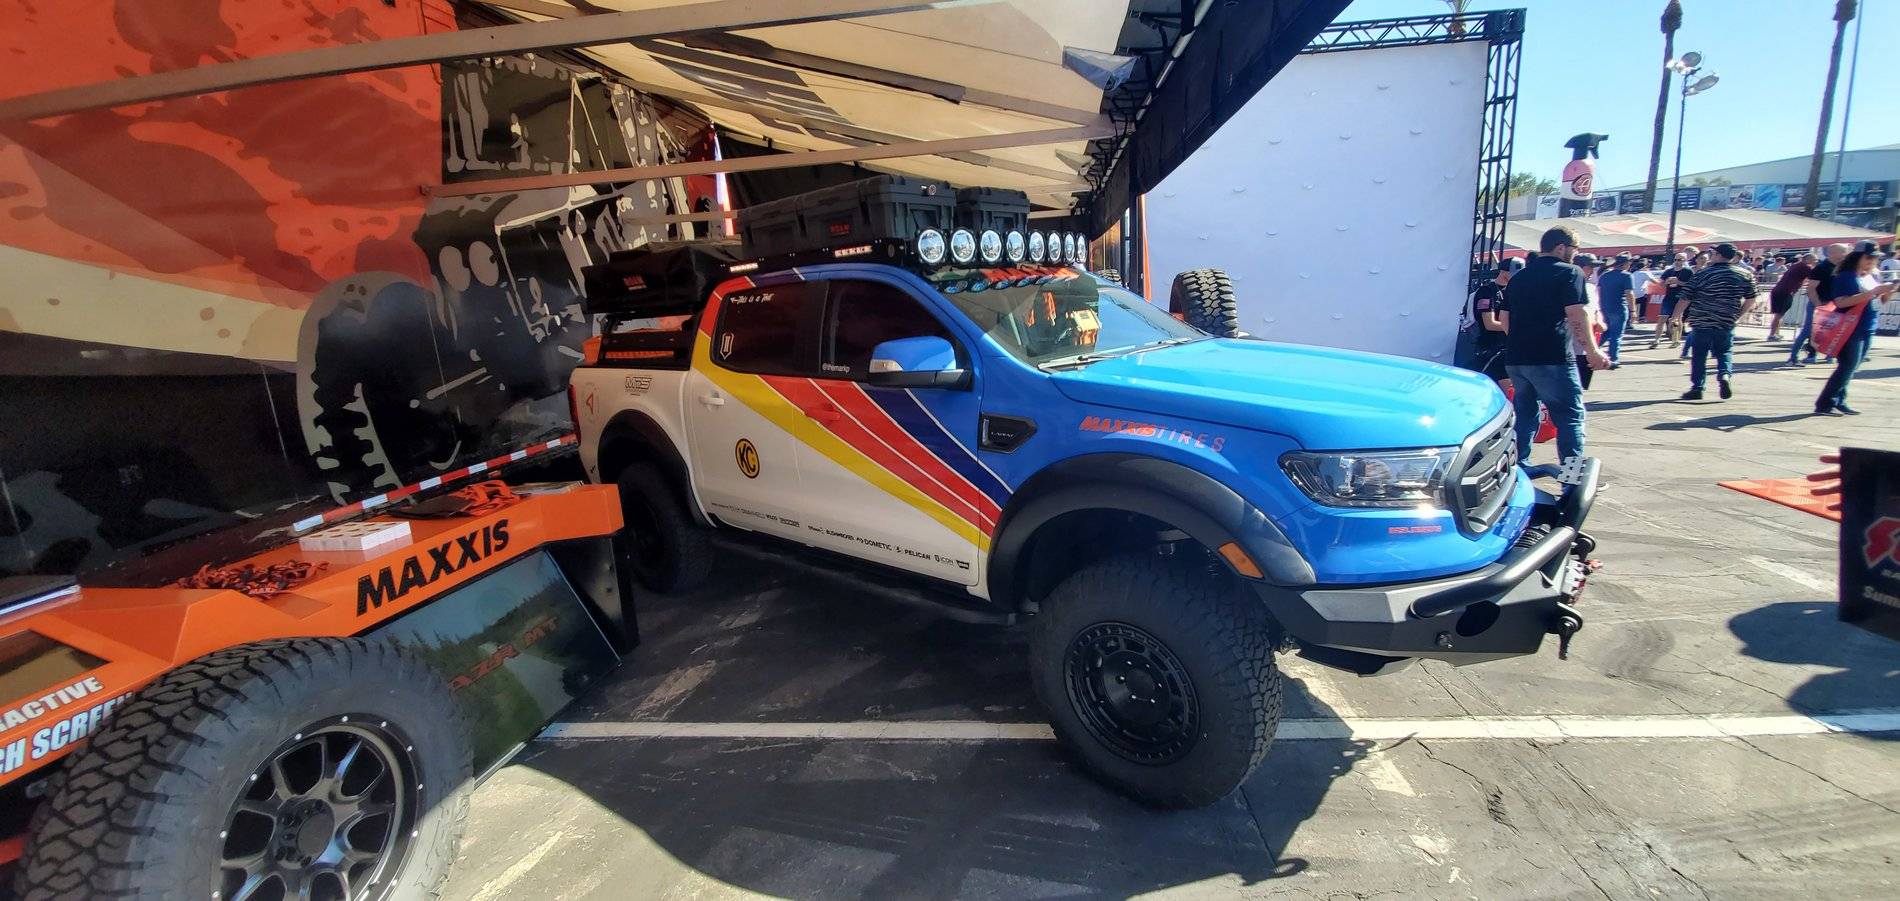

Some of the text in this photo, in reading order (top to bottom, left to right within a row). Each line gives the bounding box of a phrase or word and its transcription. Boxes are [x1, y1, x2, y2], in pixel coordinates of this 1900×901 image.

[1155, 423, 1226, 453] TIRES
[864, 539, 892, 551] DOMETIC
[904, 549, 931, 561] PELICAN
[356, 518, 510, 617] MAXXIS
